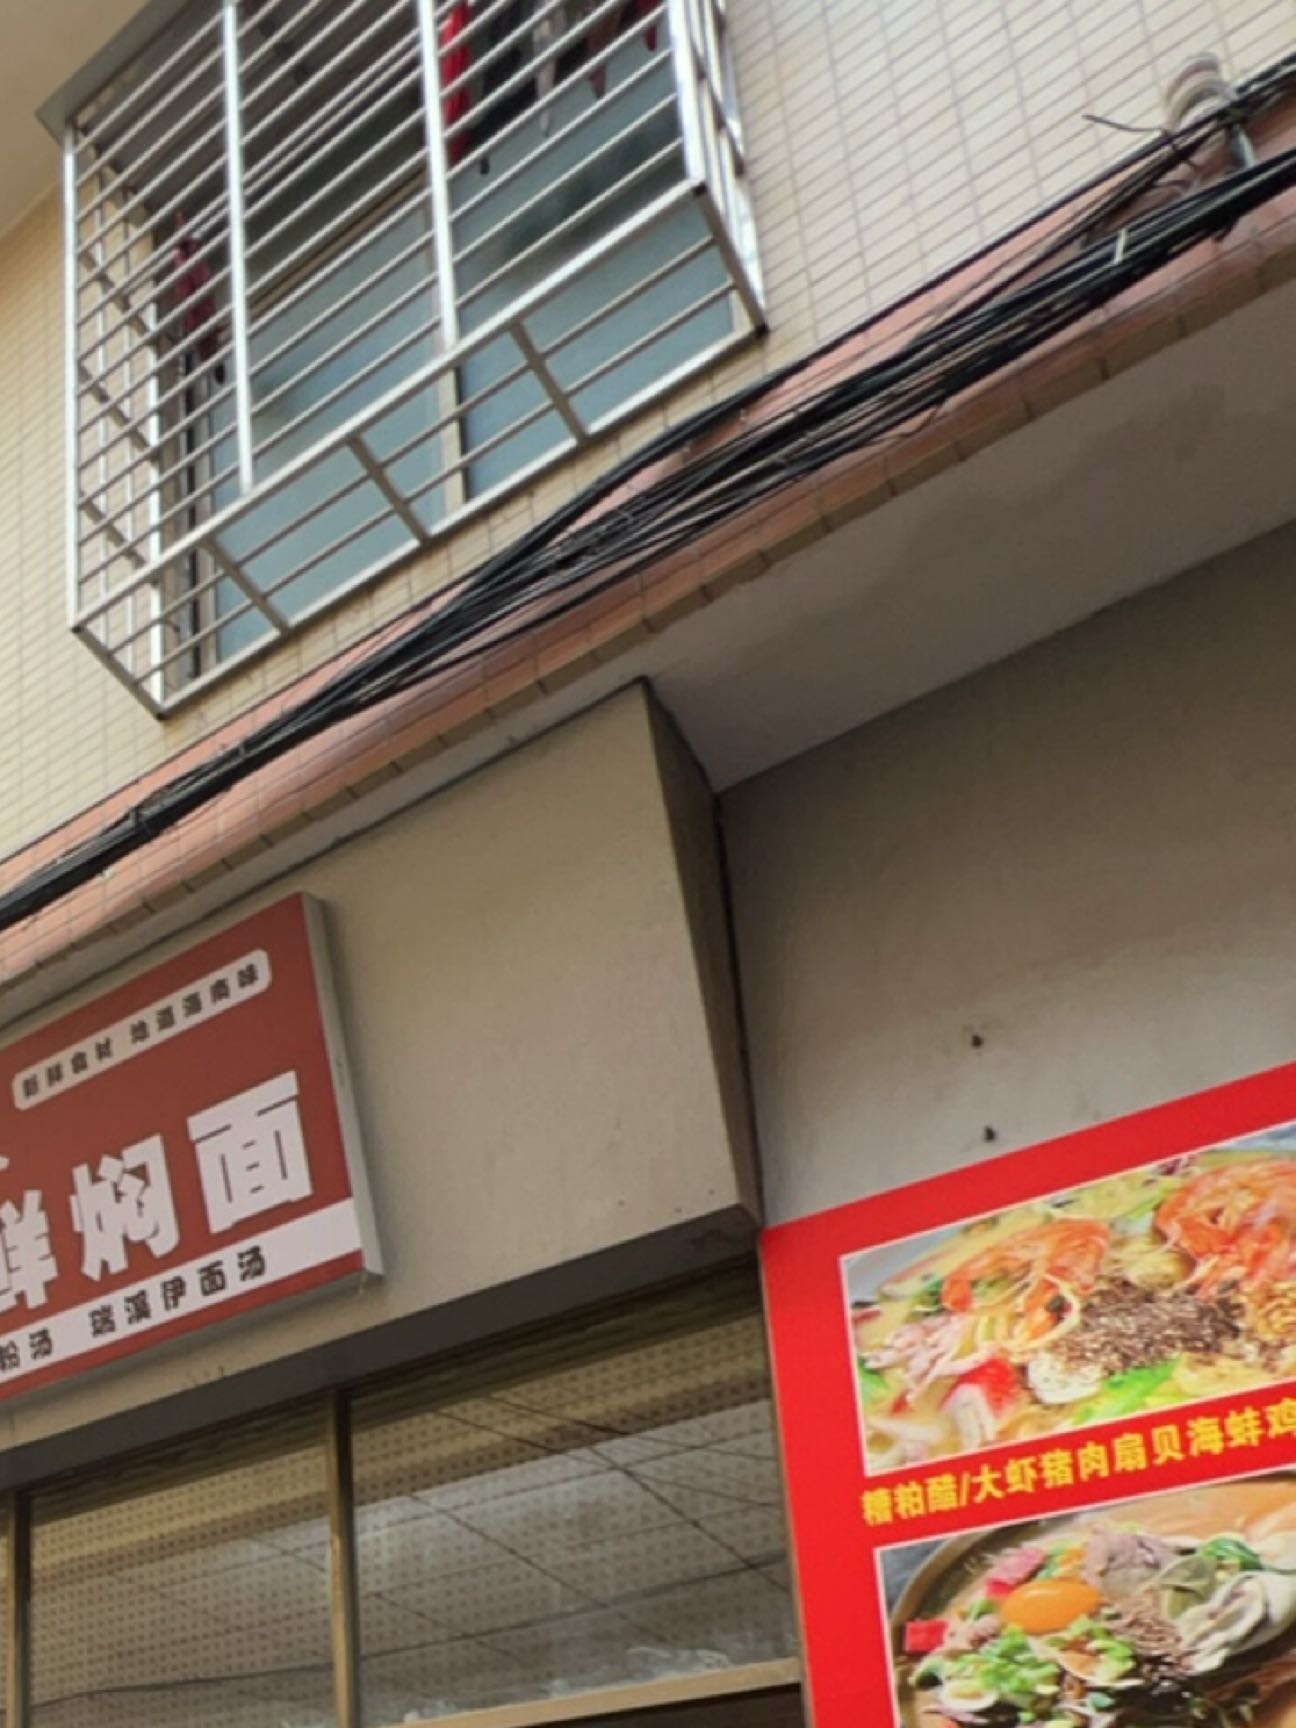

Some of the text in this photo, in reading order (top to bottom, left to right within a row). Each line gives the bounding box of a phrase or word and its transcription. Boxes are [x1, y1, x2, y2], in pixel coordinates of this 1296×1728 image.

[88, 1245, 266, 1338] 瑞溪伊面汤
